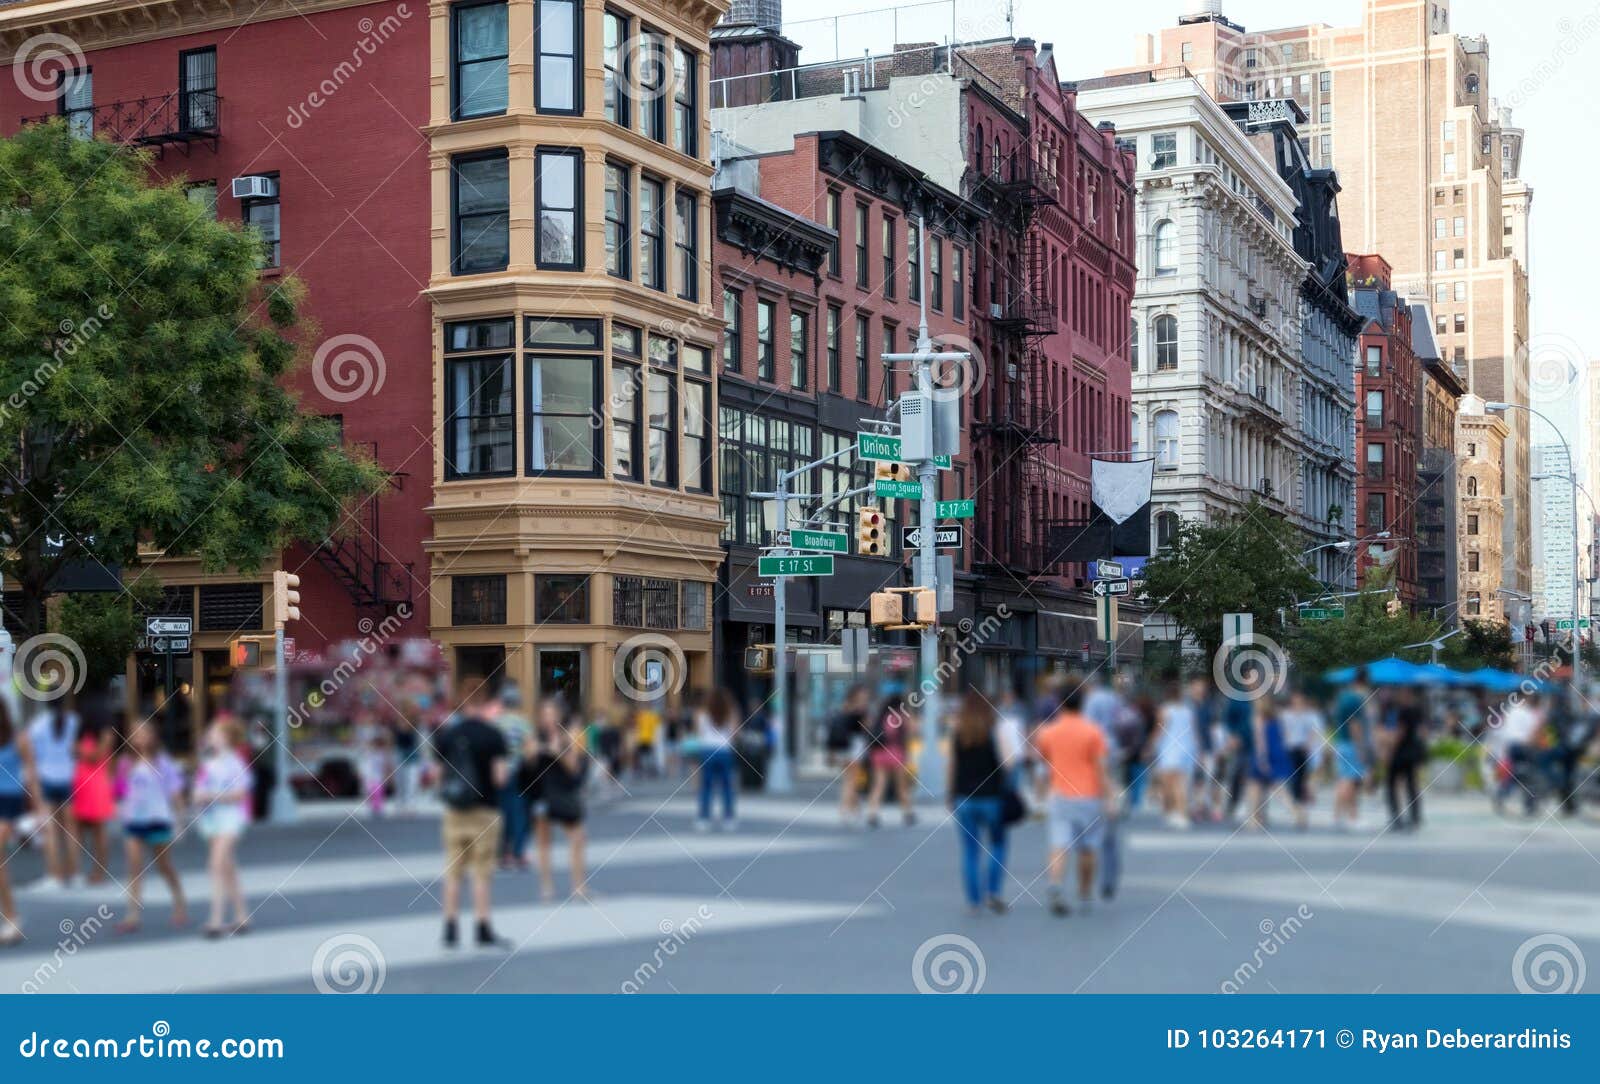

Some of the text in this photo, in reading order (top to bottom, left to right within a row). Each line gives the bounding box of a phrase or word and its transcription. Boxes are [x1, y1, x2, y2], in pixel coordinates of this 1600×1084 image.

[863, 439, 890, 457] Union
[876, 481, 921, 494] Union Square
[940, 503, 945, 516] E
[949, 503, 959, 515] 17
[804, 535, 836, 550] Broadway
[779, 560, 813, 572] E 17 St
[1114, 583, 1126, 591] WAY
